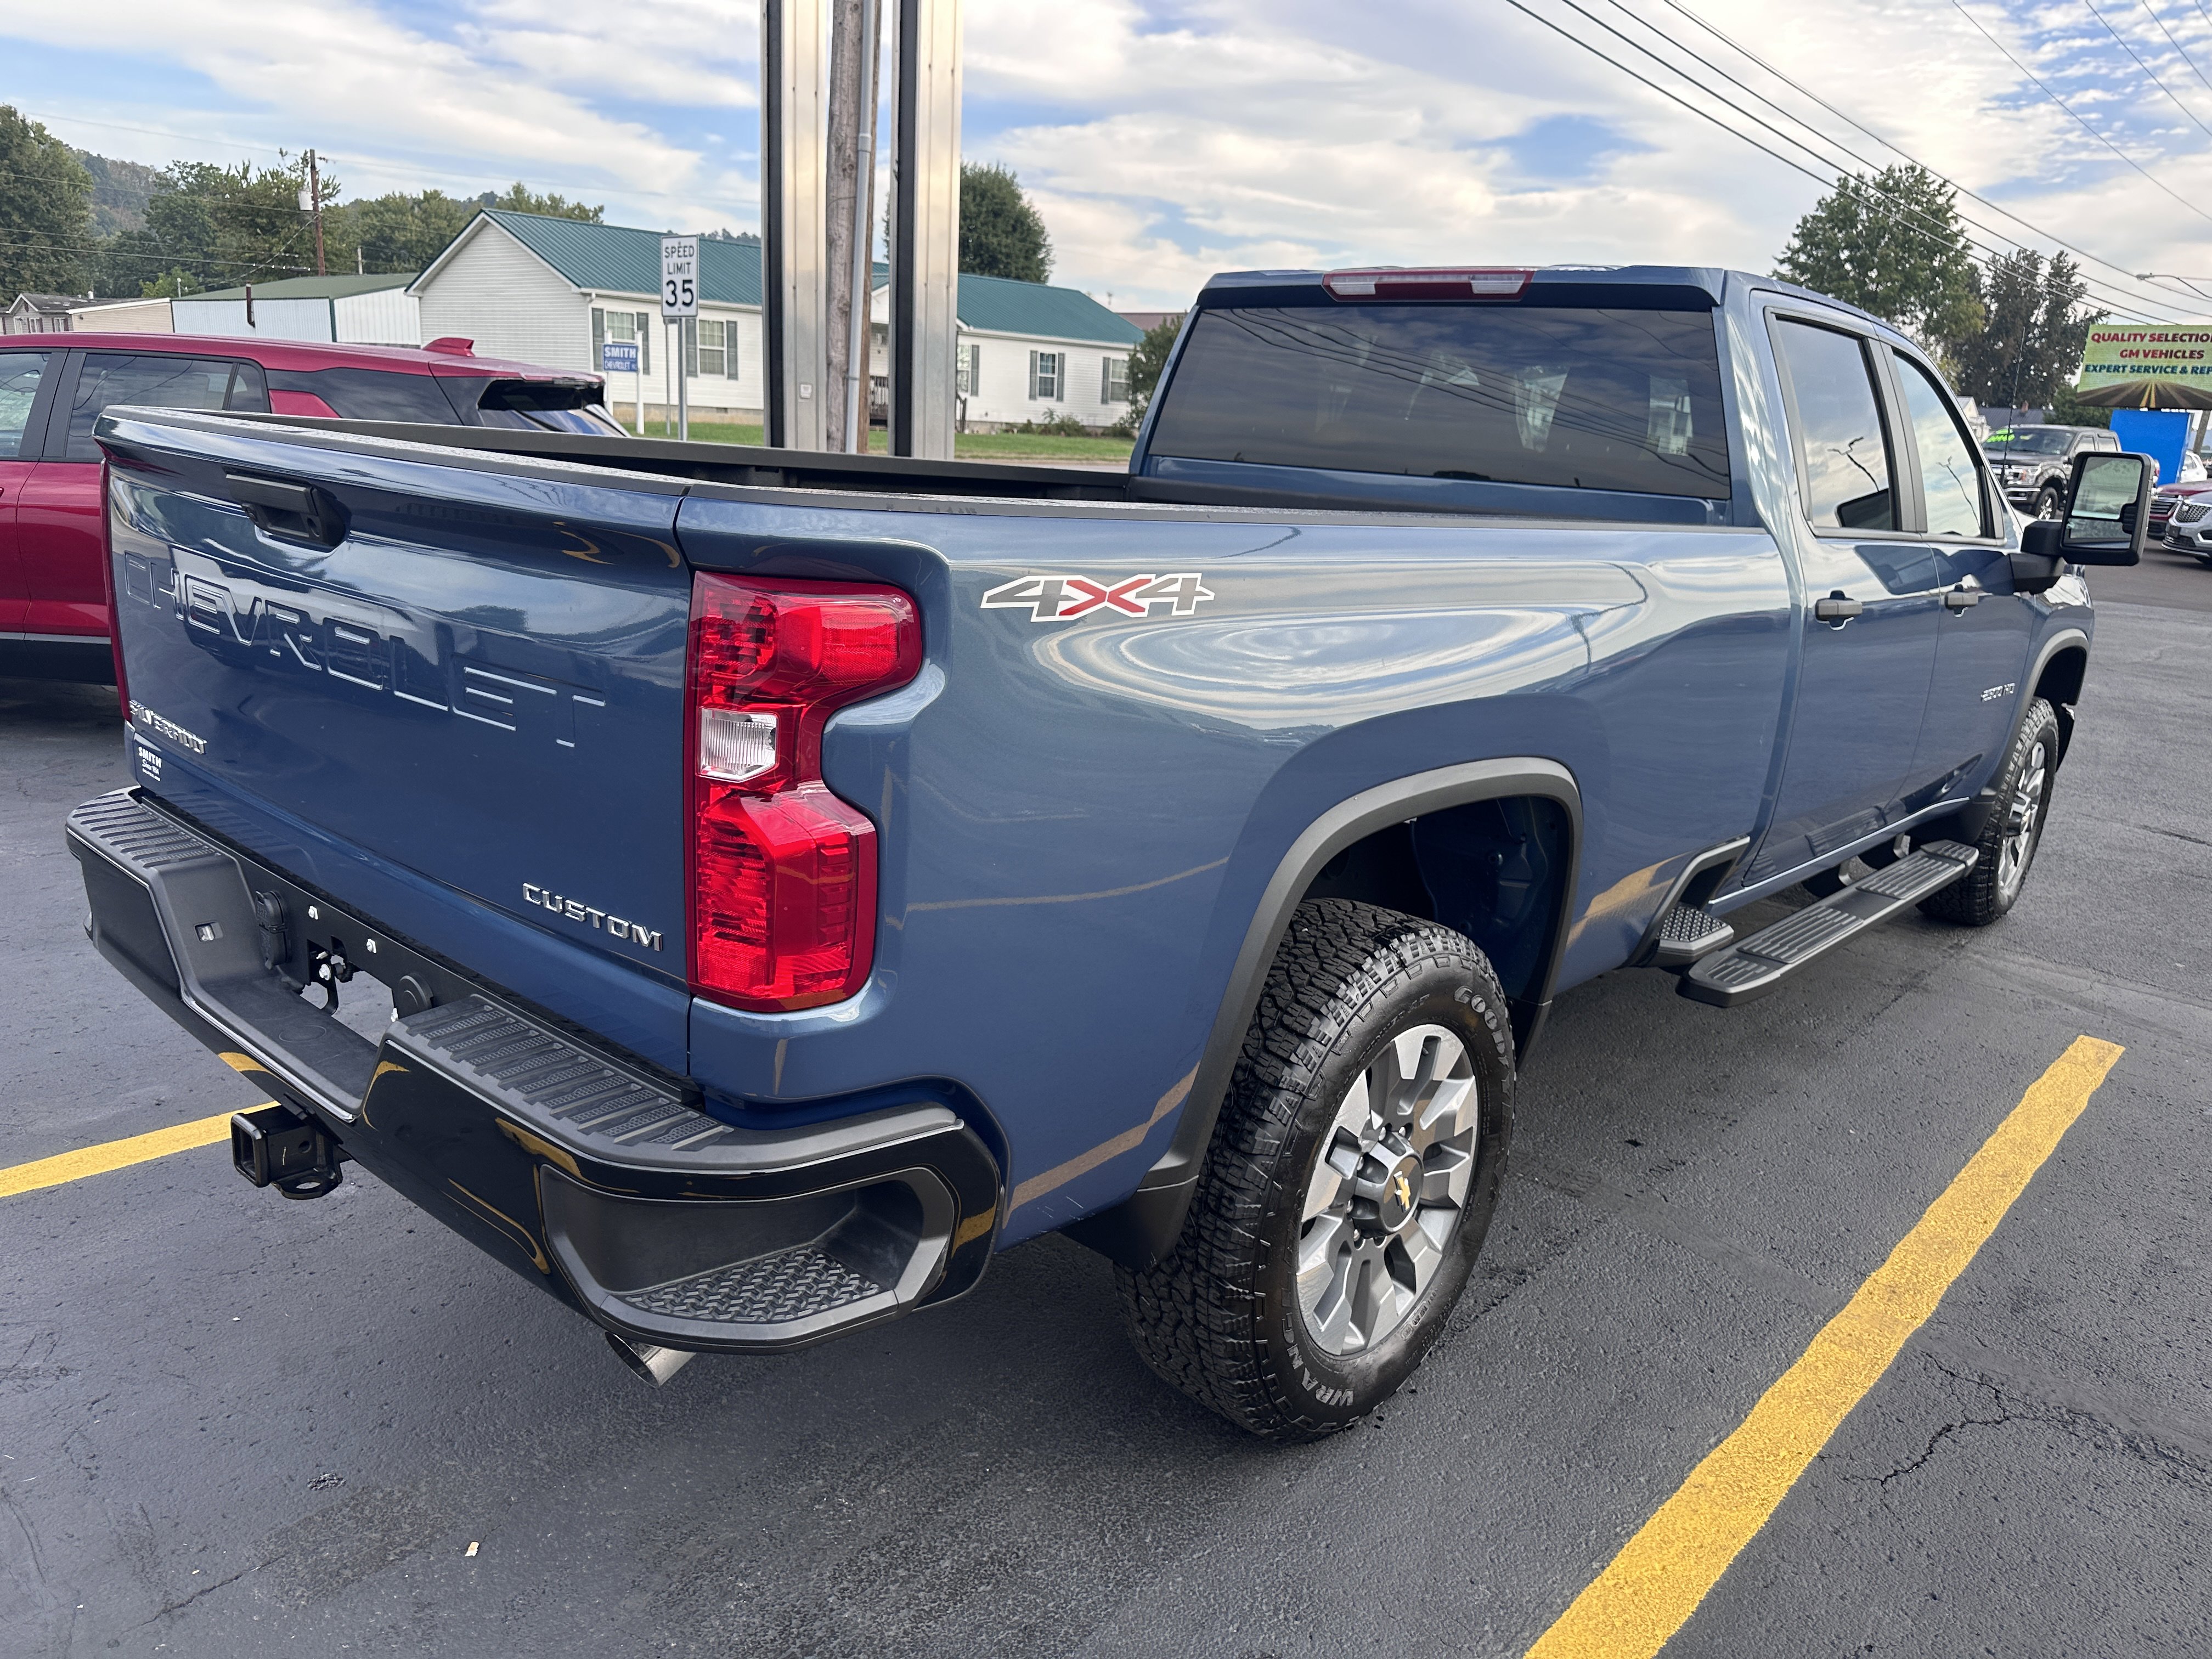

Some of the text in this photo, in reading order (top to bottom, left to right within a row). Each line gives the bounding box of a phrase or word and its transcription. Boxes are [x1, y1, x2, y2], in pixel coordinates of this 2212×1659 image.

[664, 245, 695, 258] SPEED
[667, 262, 691, 275] LIMIT
[665, 279, 694, 307] 35
[2091, 332, 2212, 343] QUALITY SELECTIO
[604, 346, 636, 358] SMITH
[2119, 348, 2204, 359] GM VEHICLES
[2085, 364, 2128, 374] EXPERT
[2129, 364, 2178, 374] SERVICE
[2179, 365, 2188, 374] &
[125, 550, 606, 747] CHEVROLET
[138, 746, 162, 768] SMITH
[523, 882, 663, 951] CUSTOM
